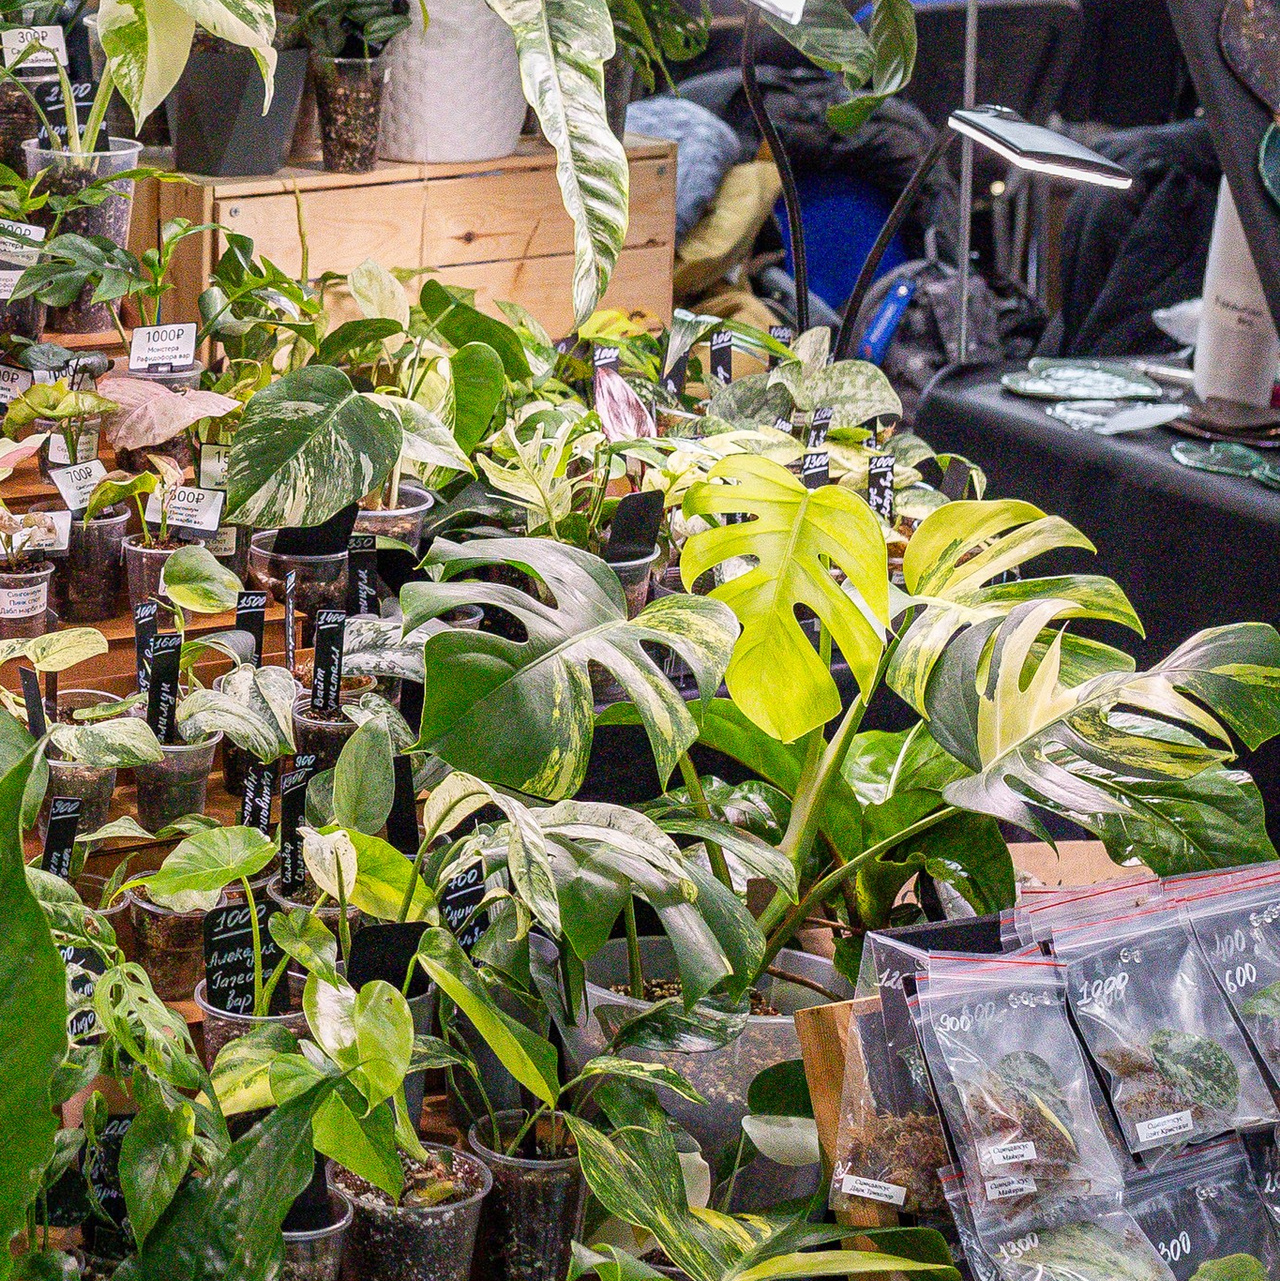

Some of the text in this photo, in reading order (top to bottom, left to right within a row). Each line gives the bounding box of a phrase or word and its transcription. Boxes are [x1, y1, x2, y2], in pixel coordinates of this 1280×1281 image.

[146, 328, 184, 343] 1000₽
[148, 345, 179, 354] Монстера
[137, 353, 177, 363] Рафидофора
[66, 467, 92, 483] 700₽
[238, 596, 266, 609] 1500
[1226, 963, 1256, 993] 600
[940, 1014, 971, 1031] 900
[998, 1232, 1038, 1264] 1300
